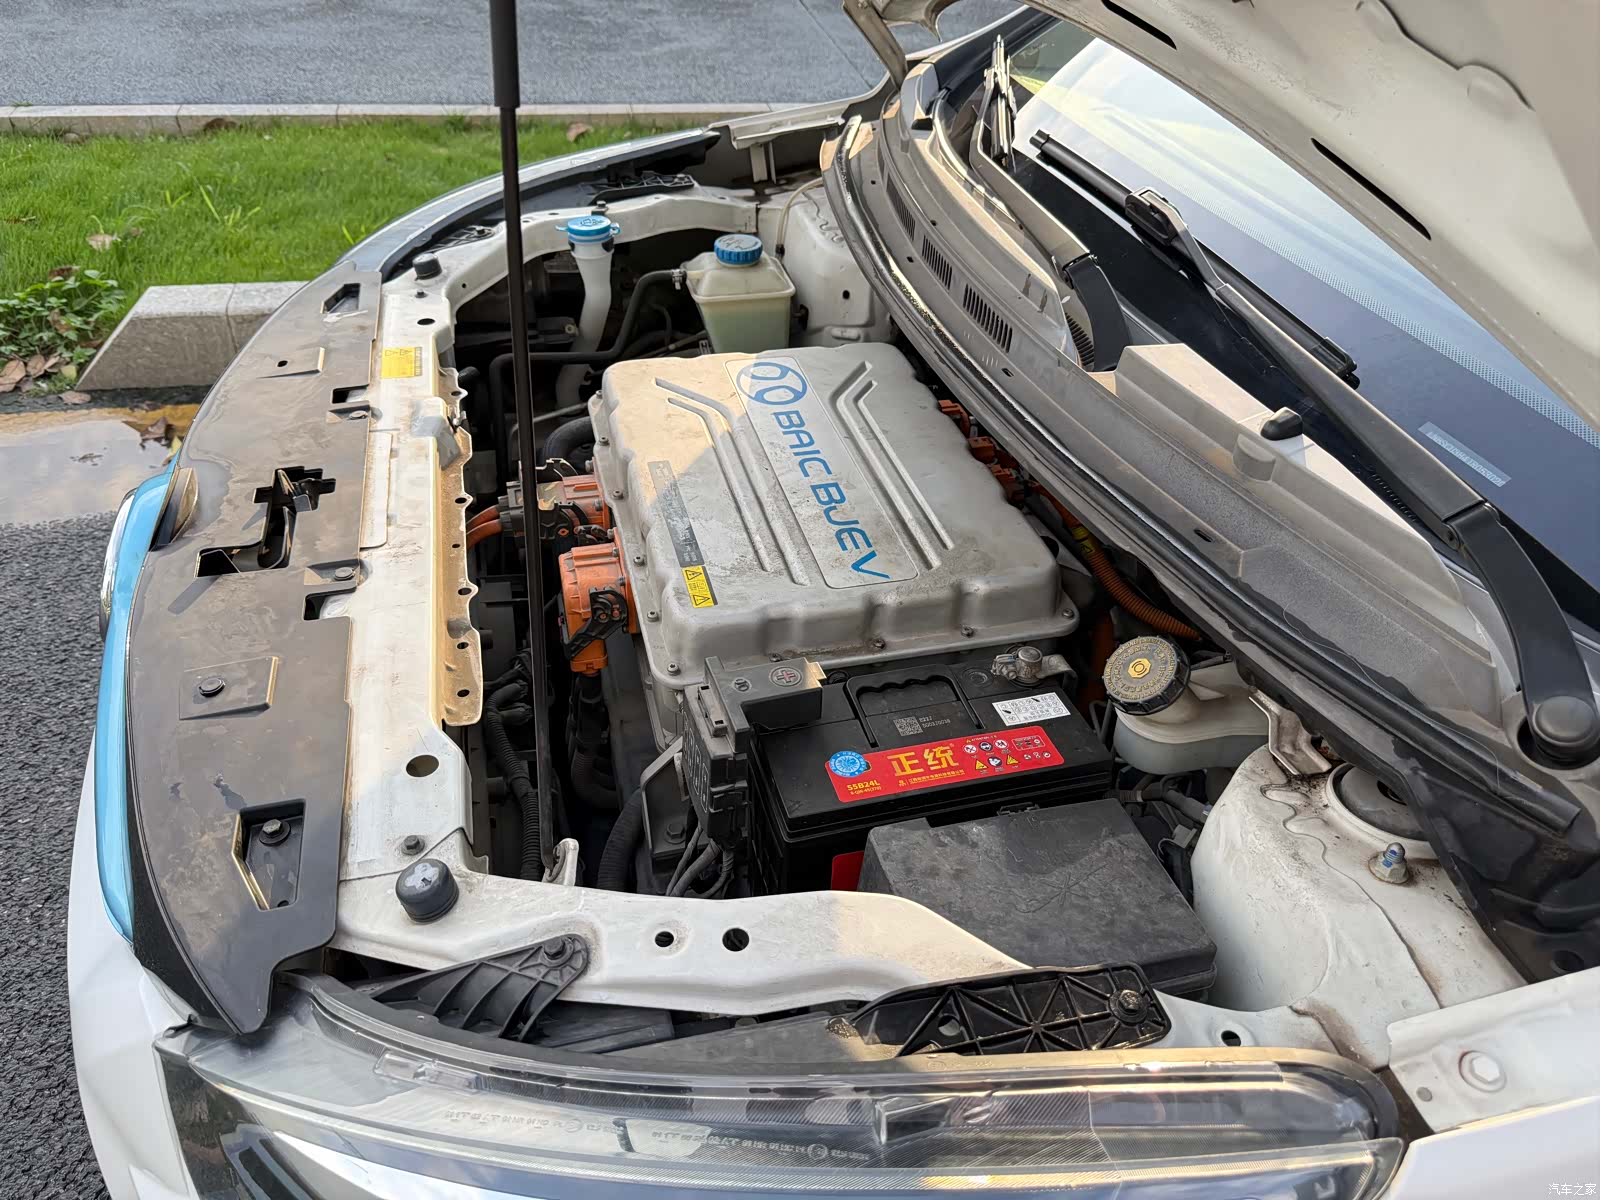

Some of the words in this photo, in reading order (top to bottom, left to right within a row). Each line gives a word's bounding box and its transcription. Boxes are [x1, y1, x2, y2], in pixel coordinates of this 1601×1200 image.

[772, 410, 832, 477] BAIC
[810, 482, 890, 579] BJEV
[887, 746, 959, 777] 正统
[846, 779, 881, 791] 55B24L
